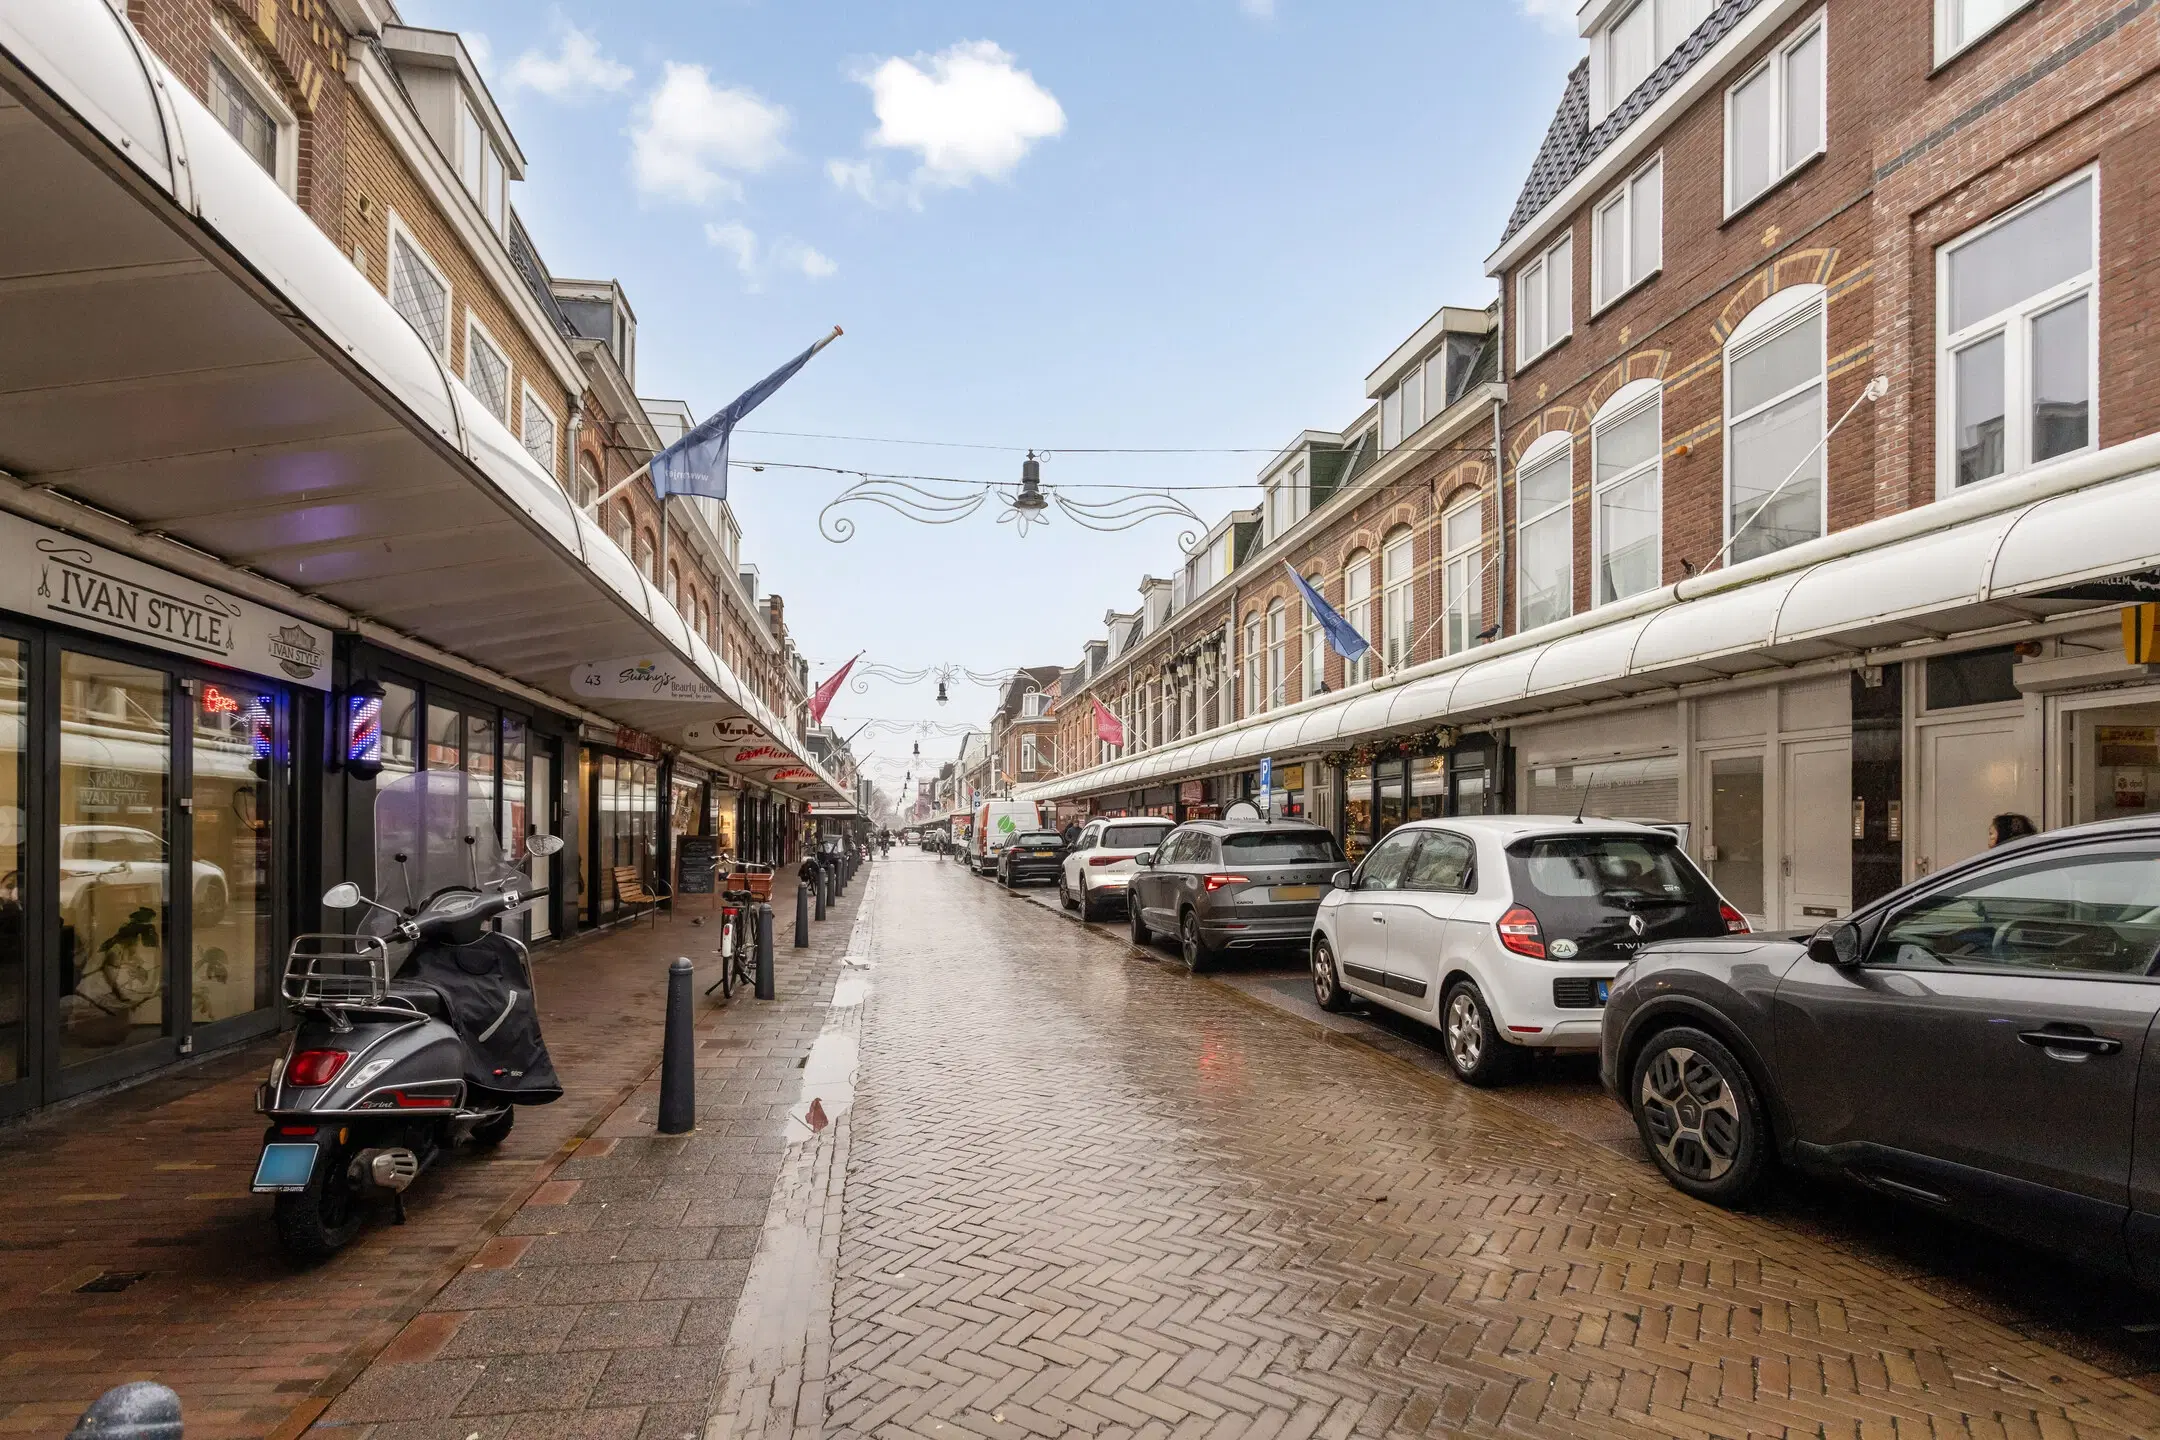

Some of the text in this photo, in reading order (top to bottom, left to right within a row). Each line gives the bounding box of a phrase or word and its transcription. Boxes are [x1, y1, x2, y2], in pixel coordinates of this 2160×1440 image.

[2091, 575, 2132, 586] ARLEM
[61, 569, 222, 646] IVAN STYLE
[273, 642, 319, 667] IVAN STYLE
[585, 674, 601, 686] 43
[619, 668, 676, 694] Sunny's
[671, 681, 697, 694] Beauty
[207, 687, 239, 713] Open
[716, 722, 765, 738] Vink
[773, 767, 818, 781] GAMEtim
[1262, 762, 1268, 781] P
[1556, 944, 1572, 953] ZA
[360, 1100, 394, 1109] Sprint
